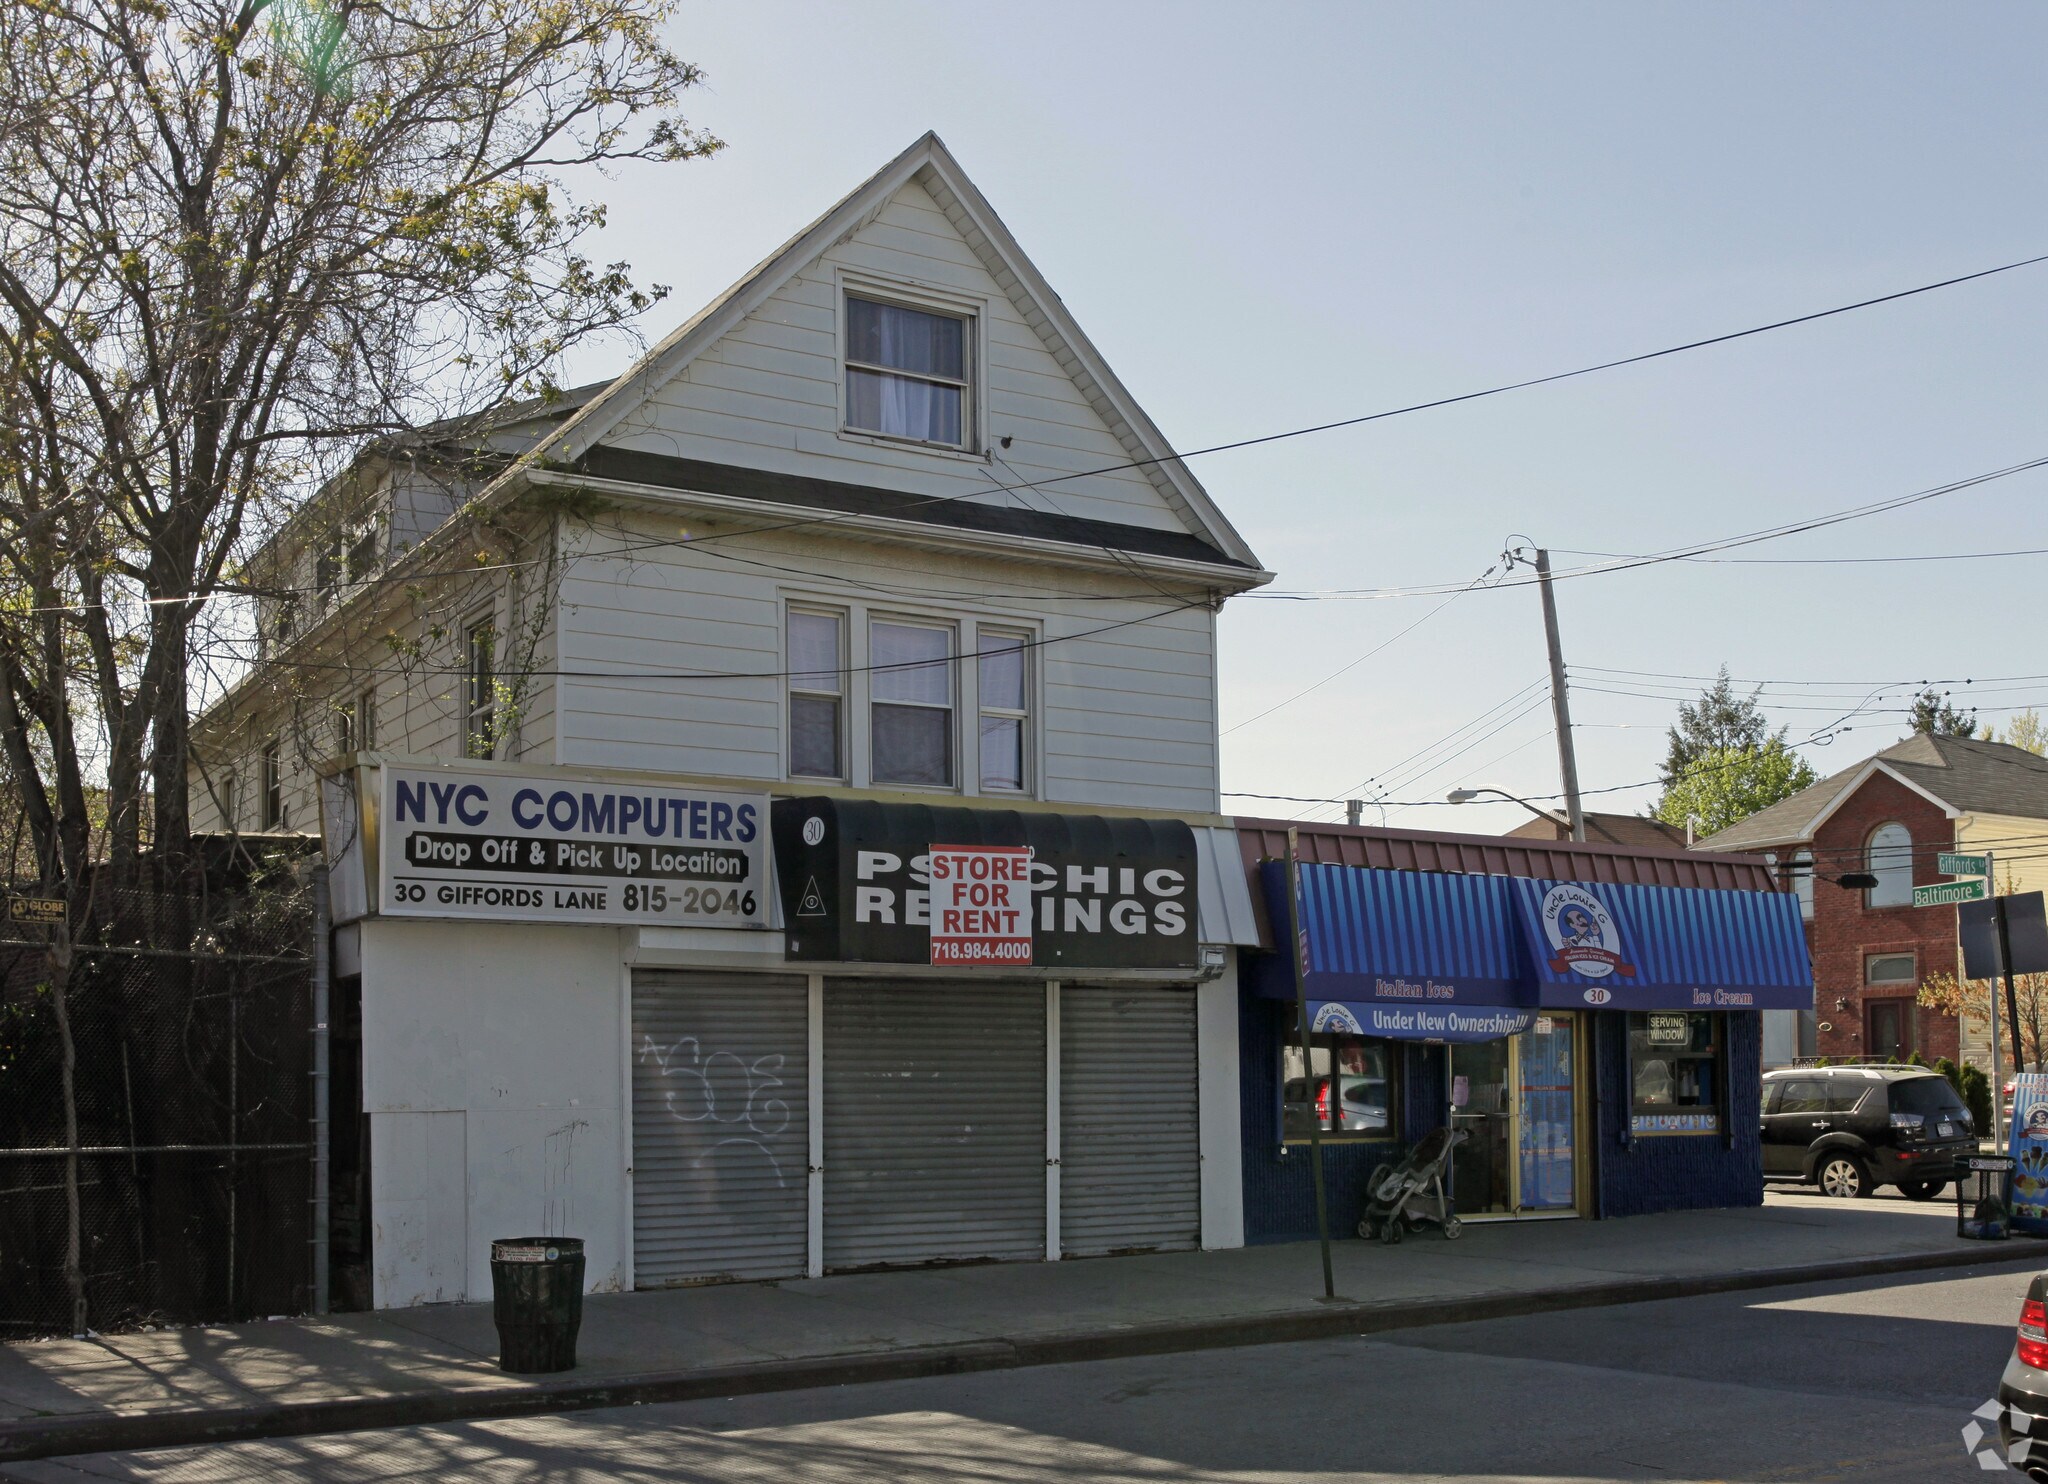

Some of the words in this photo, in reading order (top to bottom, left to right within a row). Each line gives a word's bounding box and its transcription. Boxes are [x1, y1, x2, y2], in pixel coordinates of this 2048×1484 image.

[395, 780, 489, 826] NYC
[511, 788, 757, 843] COMPUTERS
[806, 821, 821, 841] 30
[415, 836, 471, 864] Drop
[482, 838, 518, 864] Off
[529, 842, 546, 865] &
[557, 842, 603, 869] Pick
[613, 846, 641, 874] Up
[651, 848, 741, 875] Location
[1940, 857, 1976, 874] Giffords
[856, 850, 1186, 898] PSCHIC
[933, 855, 1028, 881] STORE
[394, 883, 427, 903] 30
[437, 885, 543, 909] GIFFORDS
[554, 891, 607, 910] LANE
[623, 884, 757, 916] 815-2046
[953, 883, 1010, 907] FOR
[1914, 886, 1973, 905] Baltimore
[1976, 882, 1985, 891] St
[29, 901, 64, 912] GLOBE
[855, 886, 1187, 936] REINGS
[1546, 893, 1566, 920] Uncle
[1566, 890, 1596, 912] Louie
[1597, 913, 1608, 924] G
[943, 909, 1020, 934] RENT
[932, 942, 1030, 959] 718.984.4000
[1376, 979, 1423, 997] Italian
[1426, 981, 1454, 998] Ices
[1590, 989, 1604, 1002] 30
[1693, 988, 1712, 1005] Ice
[1714, 989, 1753, 1005] Cream
[1373, 1010, 1414, 1030] Under
[1417, 1011, 1445, 1031] New
[1448, 1012, 1529, 1036] Ownership!!!
[1650, 1017, 1685, 1028] SERVING
[1650, 1029, 1685, 1040] WINDOW
